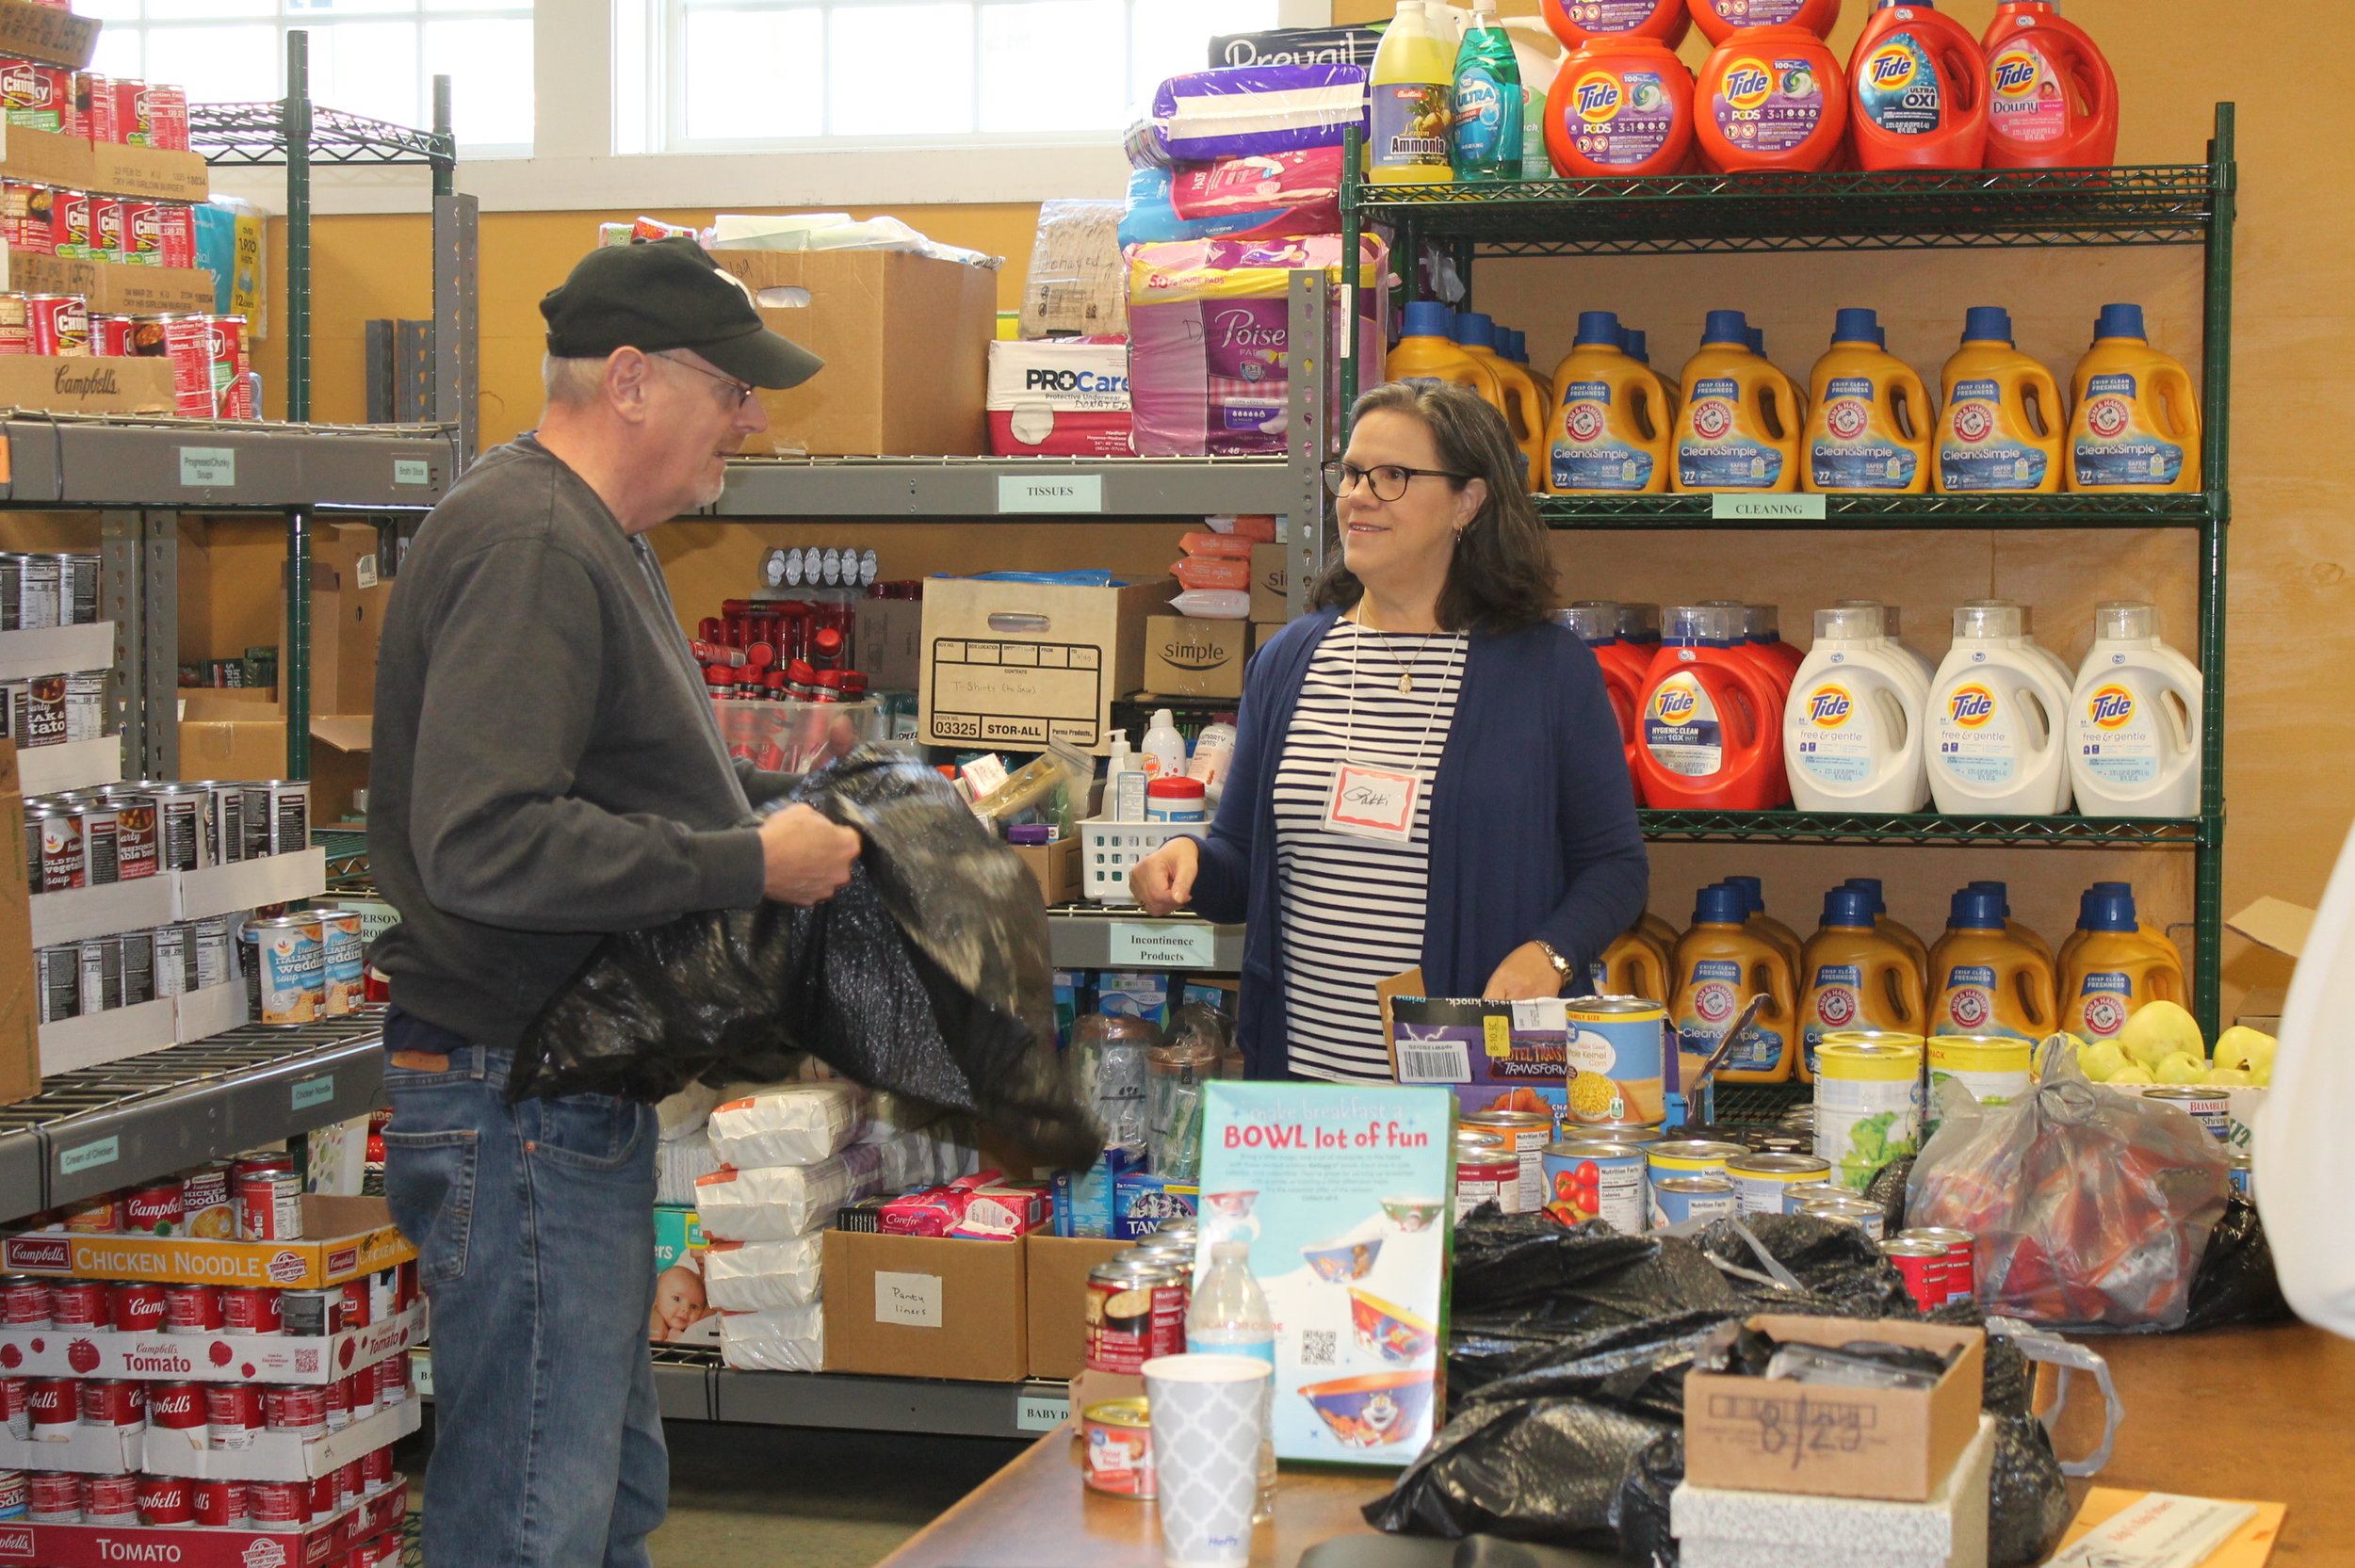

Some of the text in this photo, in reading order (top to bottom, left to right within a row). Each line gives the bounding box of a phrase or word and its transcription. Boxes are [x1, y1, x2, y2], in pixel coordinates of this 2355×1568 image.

[1226, 32, 1355, 67] Prevail
[1873, 57, 1911, 83] Tide
[1995, 64, 2034, 89] Tide
[1727, 71, 1768, 102] Tide
[1458, 87, 1495, 107] ULTRA
[1577, 83, 1618, 115] Tide
[1906, 95, 1936, 107] OXI
[1732, 110, 1761, 121] PODS
[1993, 101, 2038, 115] Downy
[1399, 123, 1429, 137] Lemon
[1584, 123, 1612, 134] PODS
[1391, 137, 1445, 154] Ammonia
[1179, 276, 1226, 284] MORE PADS
[1214, 309, 1287, 348] Poise
[54, 364, 118, 400] Campbell's
[1074, 400, 1129, 411] DONATED
[1947, 476, 1957, 484] 77
[2080, 471, 2091, 479] 77
[1026, 485, 1074, 497] TISSUES
[1735, 504, 1803, 515] CLEANING
[1164, 641, 1224, 663] simple
[1659, 692, 1694, 716] Tide
[1811, 695, 1850, 720] Tide
[1953, 695, 1992, 720] Tide
[2093, 695, 2131, 723] Tide
[935, 721, 977, 736] 03325
[987, 724, 1041, 736] STOR-ALL
[1052, 728, 1068, 736] Perma
[1800, 731, 1862, 741] free gentle
[1941, 731, 2005, 741] free gentle
[2083, 733, 2146, 742] free gentle
[1343, 785, 1389, 806] Patti
[46, 875, 71, 887] soup
[1130, 935, 1194, 947] Incontinence
[275, 953, 313, 965] ITALIAN
[1140, 950, 1184, 963] Products
[1583, 1050, 1607, 1059] Kernel
[296, 1084, 331, 1100] Chicken Noodle
[1250, 1096, 1403, 1122] make breakfast a
[2190, 1101, 2224, 1111] BUMBLE
[1224, 1122, 1428, 1149] BOWL lot of fun
[65, 1145, 114, 1166] Cream of Chicken
[11, 1240, 261, 1279] Campbell's CHICKEN NOODLE
[275, 1268, 303, 1278] POP TOP
[892, 1286, 925, 1303] Panty
[895, 1303, 927, 1317] liners
[136, 1339, 178, 1356] Campbell's
[370, 1332, 399, 1356] Tomato
[122, 1353, 191, 1374] Tomato
[1027, 1408, 1057, 1419] BABY
[1760, 1392, 1862, 1469] 8/23
[348, 1512, 378, 1539] TOMATO
[97, 1538, 181, 1563] TOMATO
